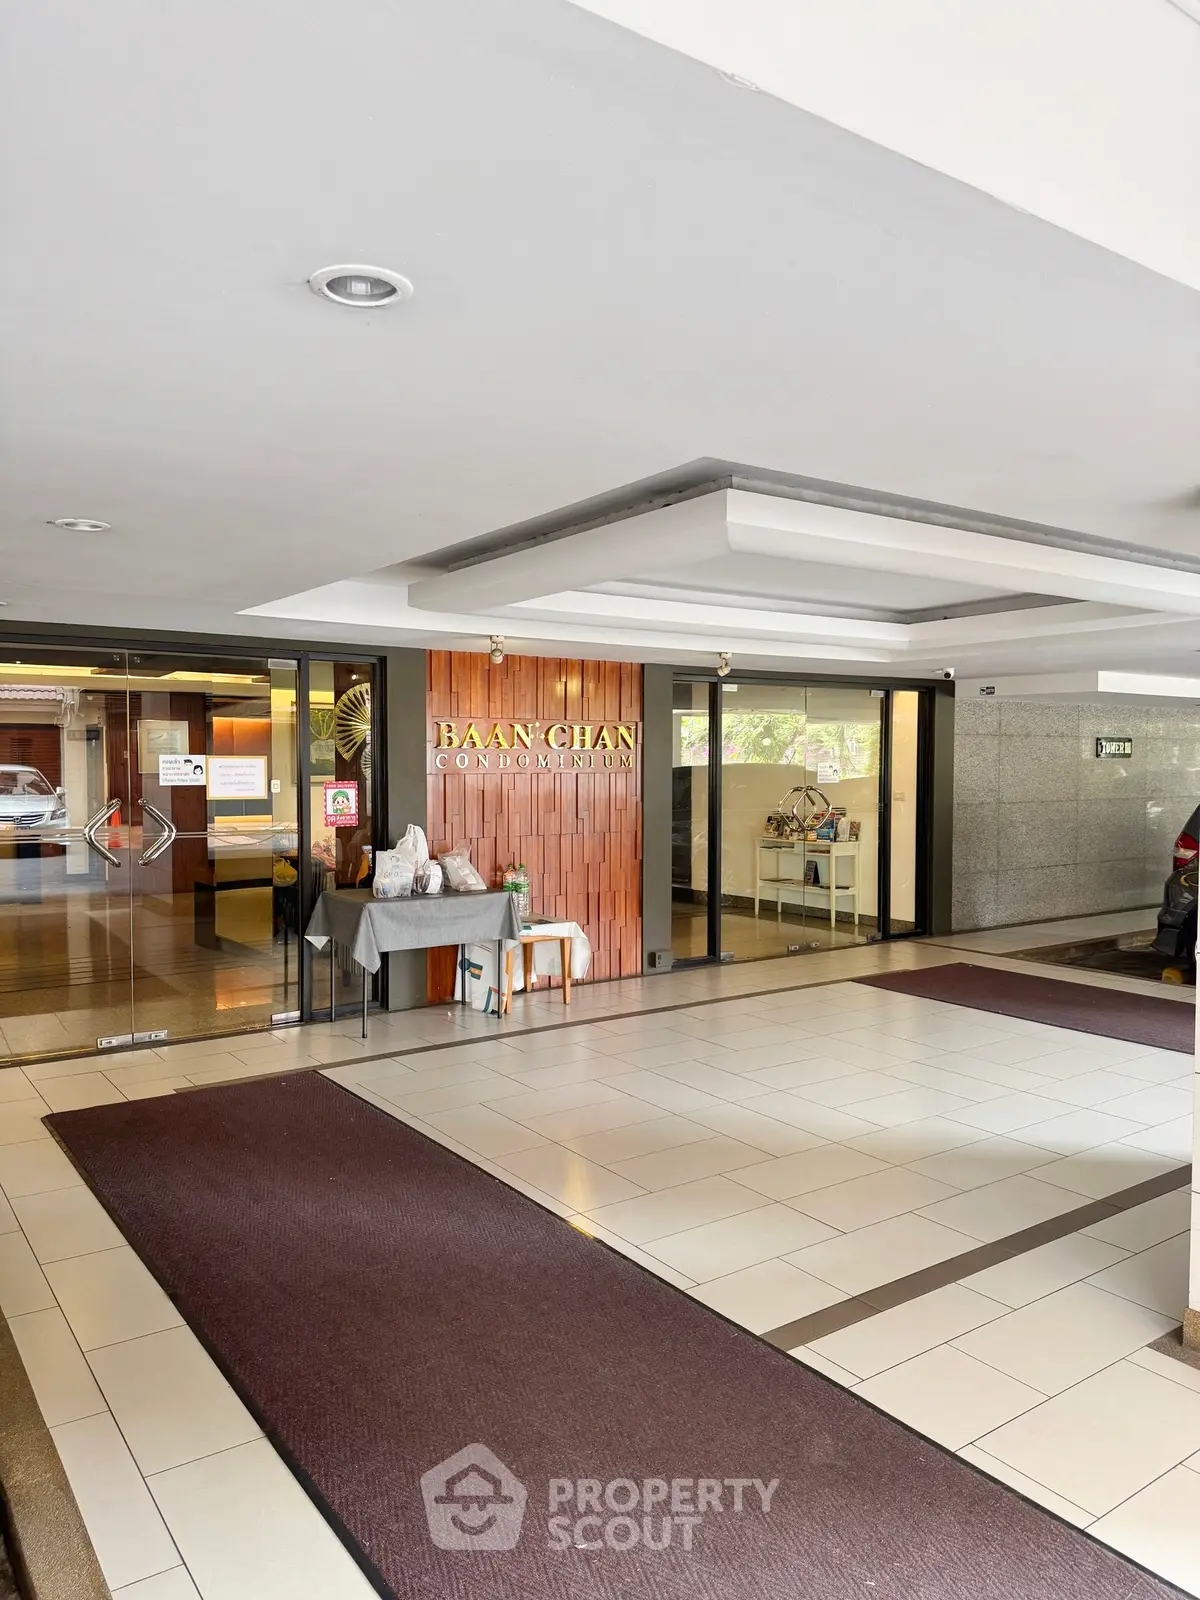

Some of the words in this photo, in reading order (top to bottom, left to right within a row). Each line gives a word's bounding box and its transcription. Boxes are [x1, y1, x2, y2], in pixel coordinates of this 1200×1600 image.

[435, 722, 533, 750] BAAN
[544, 723, 636, 751] CHAN
[1102, 742, 1124, 753] TOWER
[435, 753, 634, 770] CONDOMINIUM
